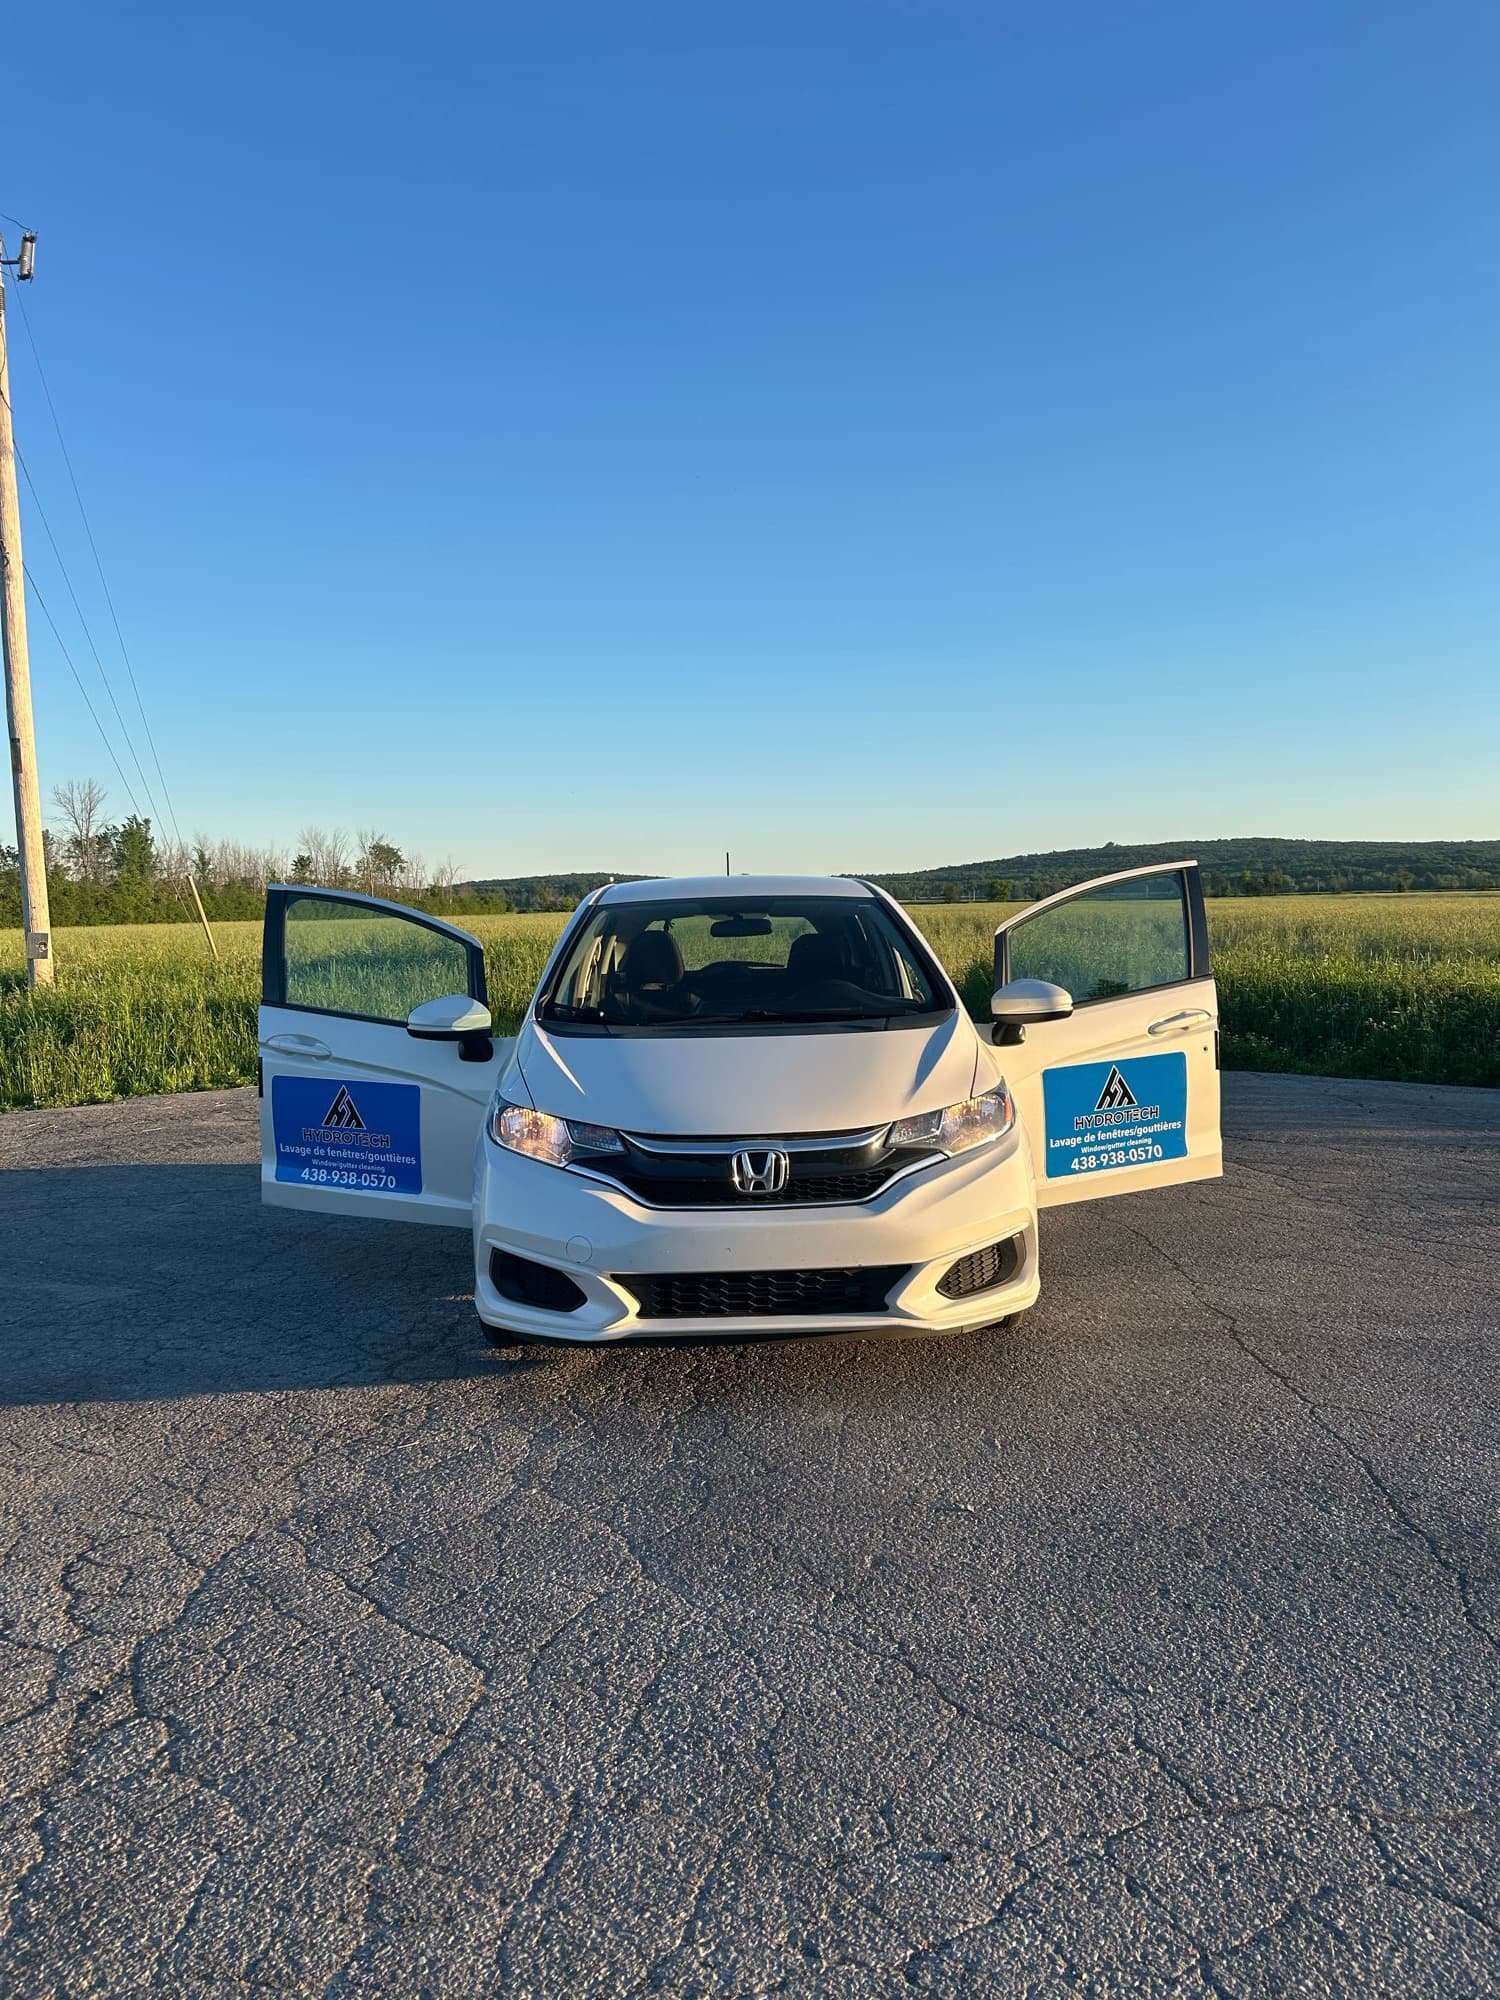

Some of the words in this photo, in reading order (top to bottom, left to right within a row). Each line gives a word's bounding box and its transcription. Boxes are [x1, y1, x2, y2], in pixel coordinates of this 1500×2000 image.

[1074, 1105, 1160, 1130] HYDROTECH
[302, 1128, 391, 1148] HYDROTECH
[1050, 1136, 1082, 1148] Lavage
[1084, 1133, 1096, 1143] de
[1097, 1121, 1182, 1141] fenêtres/gouttières
[1081, 1141, 1126, 1153] Window/gutter
[1127, 1137, 1152, 1147] cleaning
[280, 1143, 311, 1156] Lavage
[313, 1146, 325, 1155] de
[327, 1147, 416, 1165] fenêtres/gouttières
[1071, 1145, 1163, 1170] 438-938-0570
[300, 1168, 396, 1188] 438-938-0570
[359, 1163, 385, 1173] cleaning
